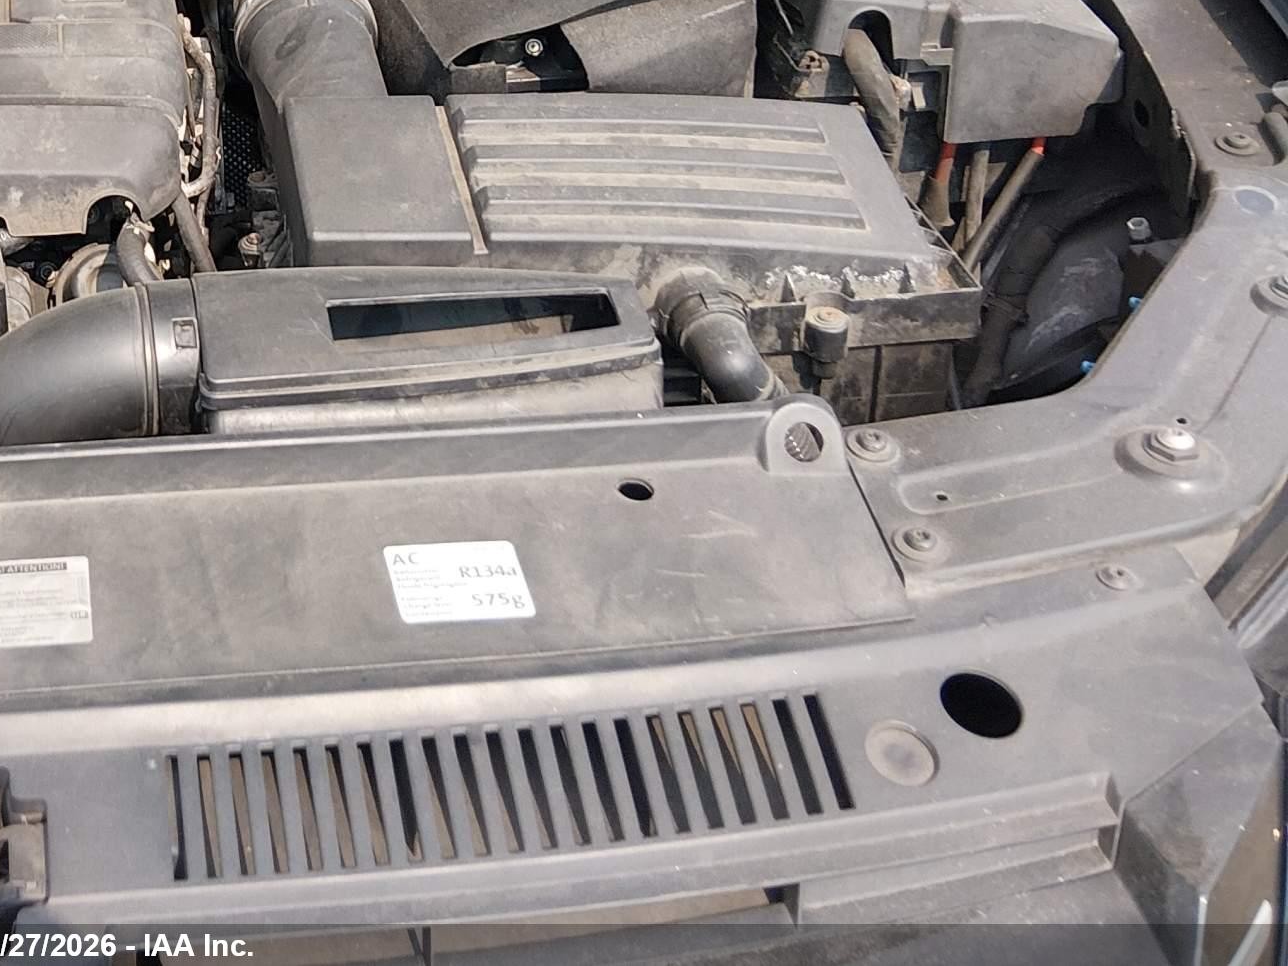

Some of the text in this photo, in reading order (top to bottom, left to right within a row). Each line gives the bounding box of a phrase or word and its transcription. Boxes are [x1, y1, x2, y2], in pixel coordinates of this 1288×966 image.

[392, 551, 419, 566] AC
[7, 561, 65, 573] ATTENTION!
[457, 564, 518, 579] R134a
